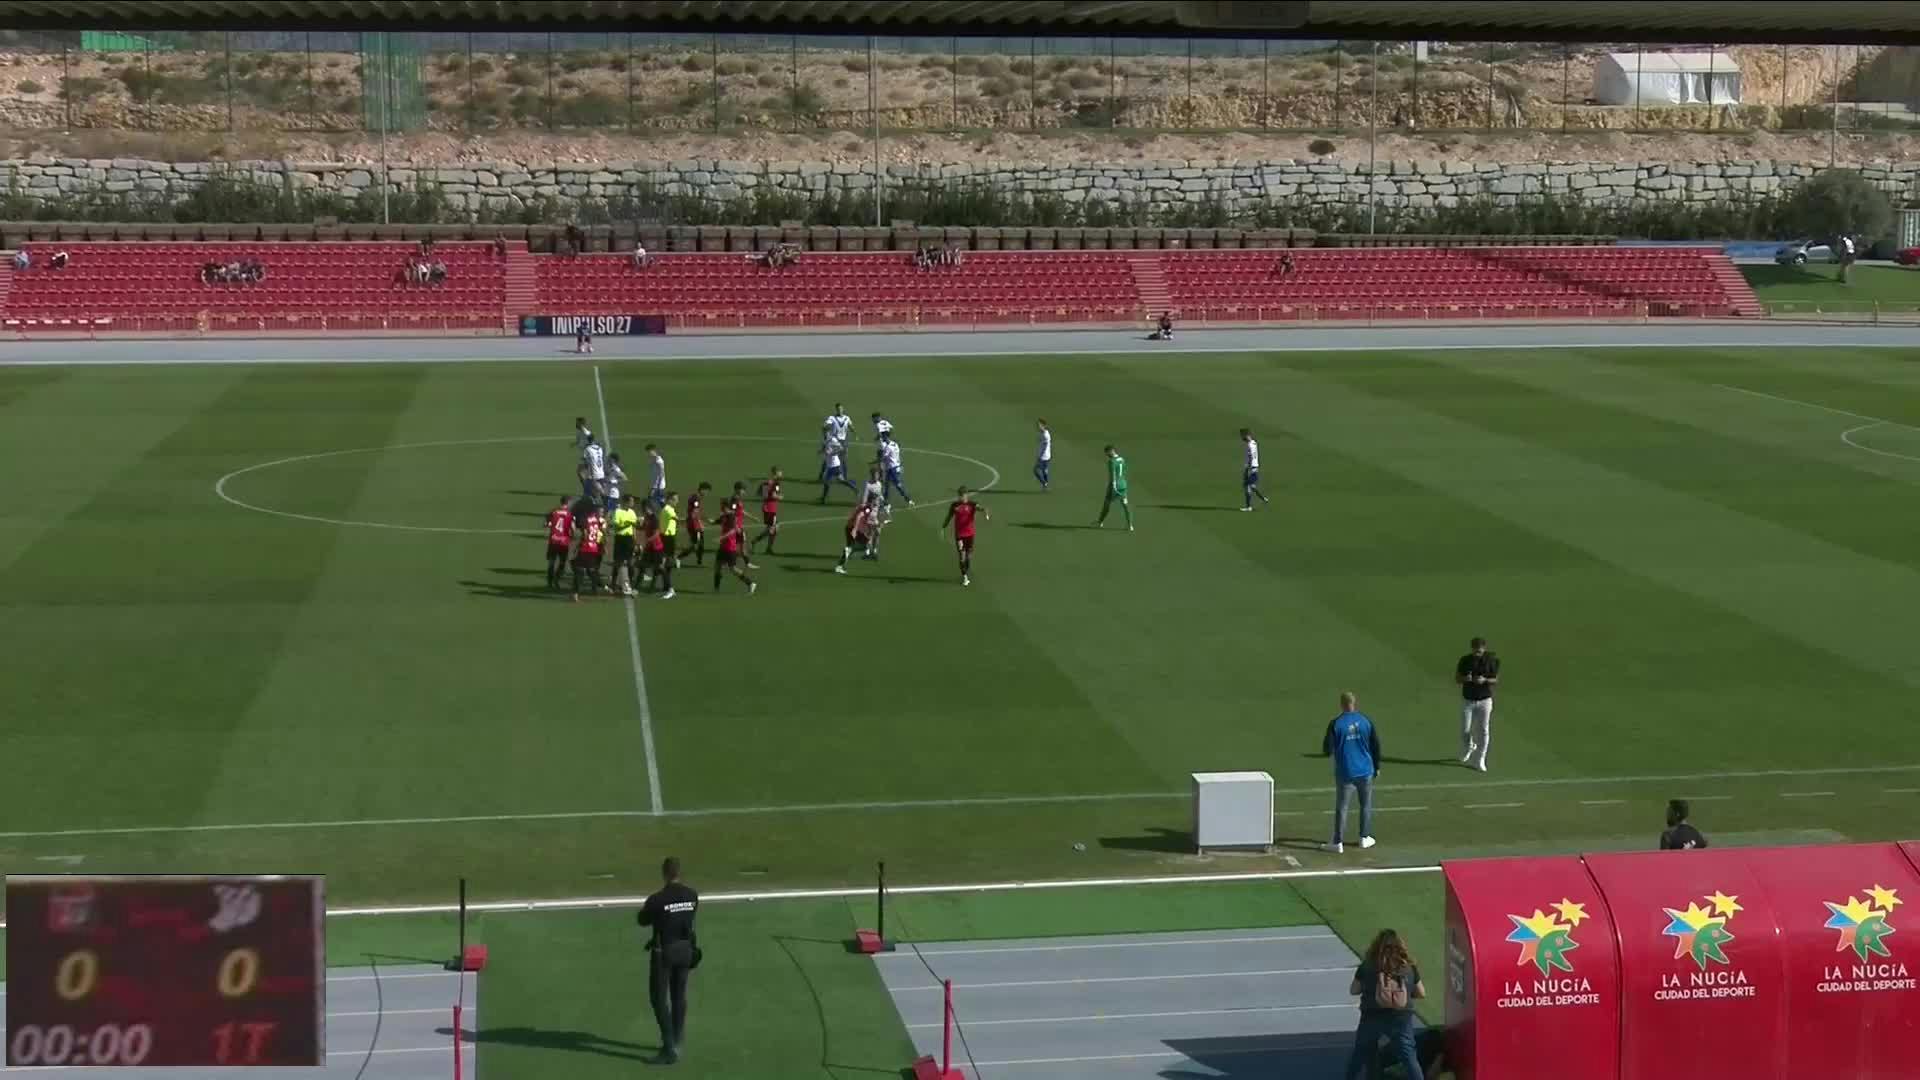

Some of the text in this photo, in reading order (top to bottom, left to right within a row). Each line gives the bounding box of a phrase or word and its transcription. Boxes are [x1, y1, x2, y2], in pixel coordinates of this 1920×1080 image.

[555, 517, 565, 532] 4
[1662, 973, 1681, 987] LA
[1824, 966, 1842, 980] LA
[1505, 981, 1524, 995] LA
[1816, 979, 1917, 992] CIUDAD DEL DEPORTE
[1654, 986, 1755, 1000] CIUDAD DEL DEPORTE
[1497, 993, 1600, 1008] CIUDAD DEL DEPORTE
